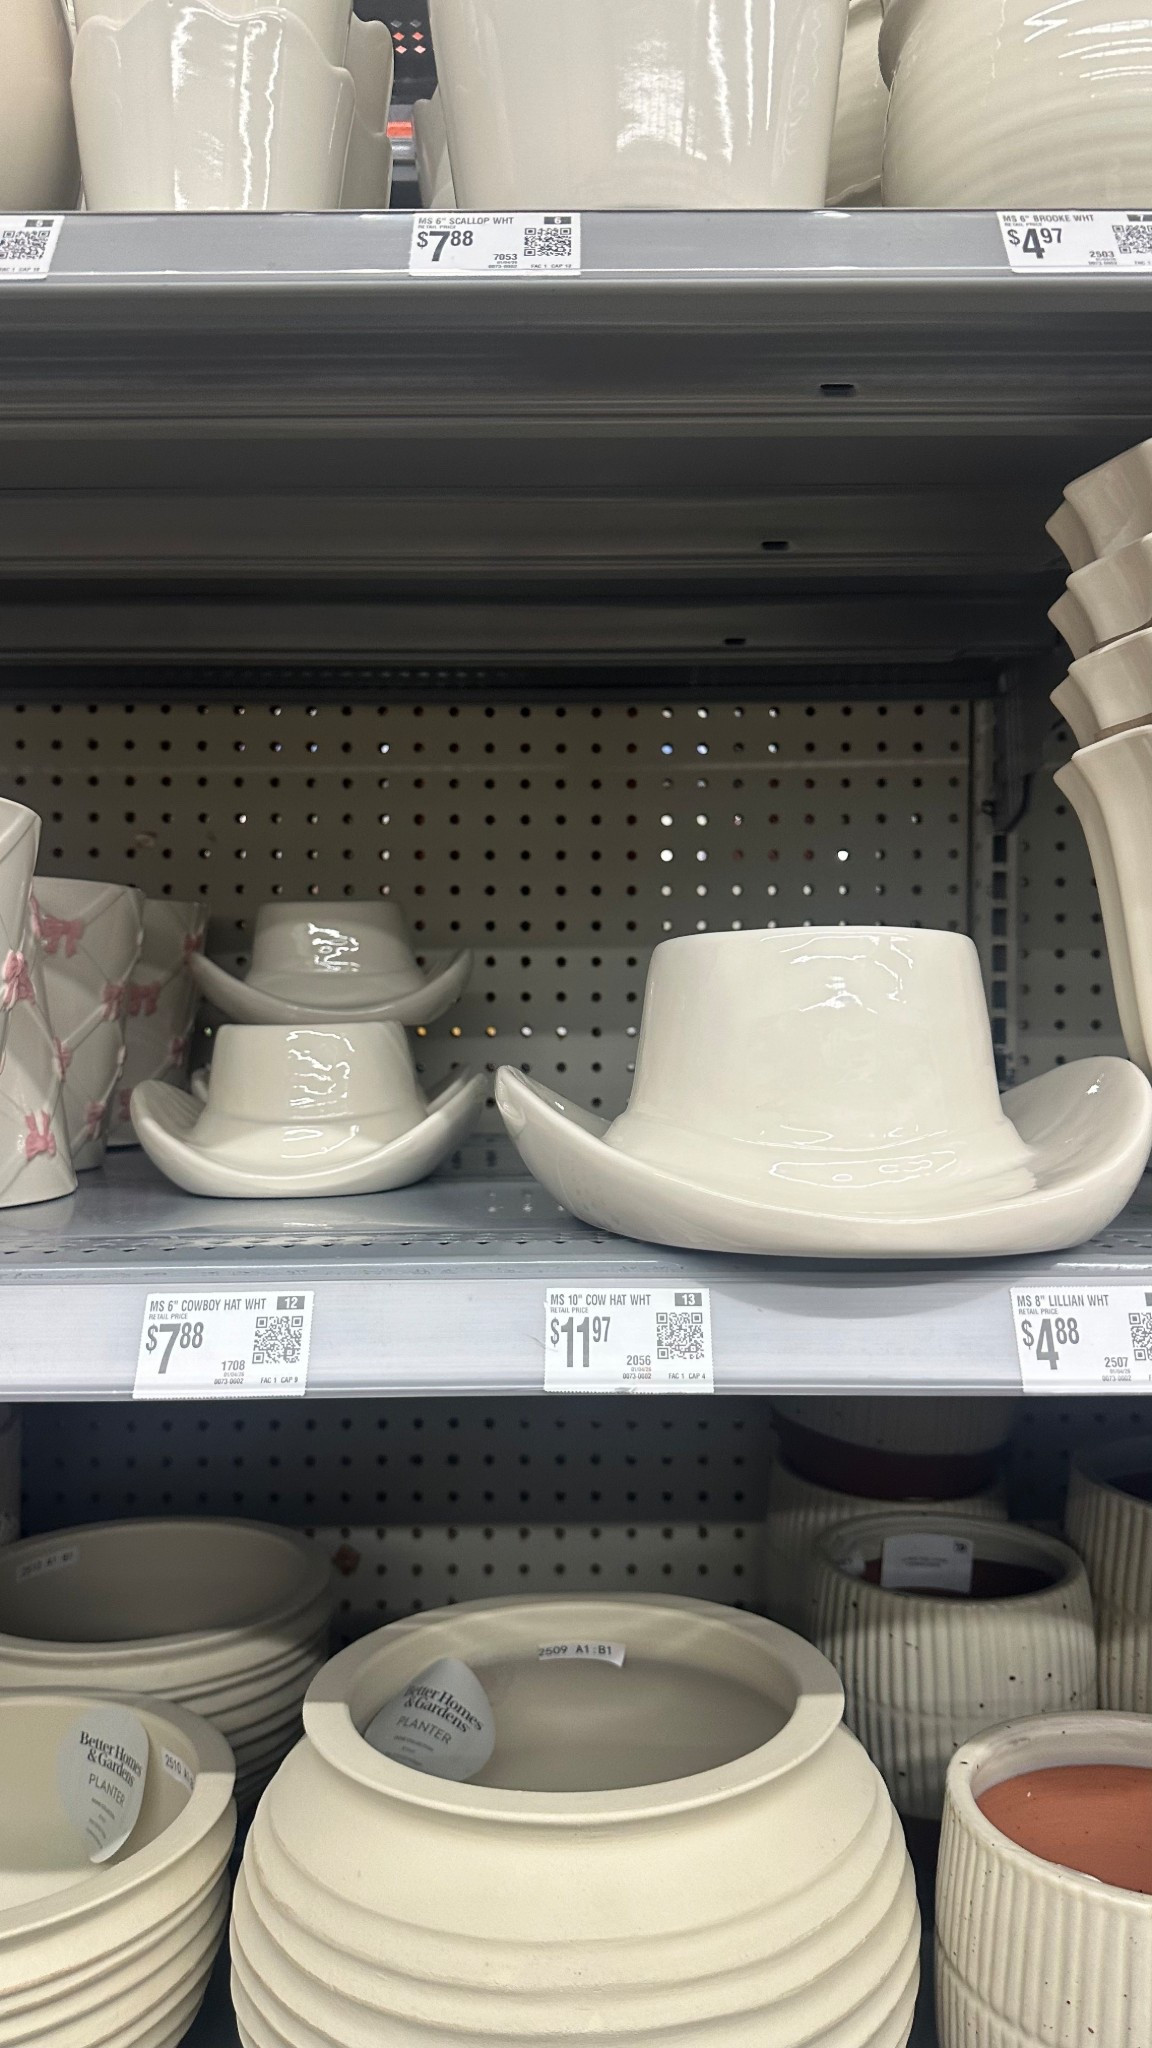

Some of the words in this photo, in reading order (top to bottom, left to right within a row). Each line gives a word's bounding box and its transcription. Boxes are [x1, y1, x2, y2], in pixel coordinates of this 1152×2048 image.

[418, 217, 433, 225] MS
[449, 217, 490, 225] SCALLOP
[493, 216, 515, 225] WHT
[1002, 214, 1017, 222] MS
[1033, 214, 1071, 222] BROOKE
[1073, 214, 1095, 222] WHT
[150, 1300, 165, 1312] MS
[167, 1299, 179, 1312] 6"
[181, 1299, 221, 1311] COWBOY
[223, 1298, 242, 1310] HAT
[245, 1298, 267, 1310] WHT
[284, 1297, 299, 1309] 12
[550, 1294, 565, 1306] MS
[568, 1294, 583, 1306] 10"
[586, 1294, 607, 1306] COW
[609, 1294, 627, 1306] HAT
[630, 1294, 651, 1306] WHT
[681, 1293, 696, 1305] 13
[1017, 1295, 1032, 1307] MS
[1048, 1295, 1085, 1307] LILLIAN
[1087, 1294, 1109, 1307] WHT
[221, 1360, 246, 1371] 1708
[626, 1354, 652, 1366] 2056
[1104, 1356, 1129, 1368] 2507
[538, 1645, 568, 1657] 2509
[438, 1690, 483, 1731] Homes
[396, 1715, 453, 1744] PLANTER
[80, 1730, 115, 1756] Better
[114, 1744, 142, 1778] Homes
[88, 1773, 126, 1808] PLANTER
